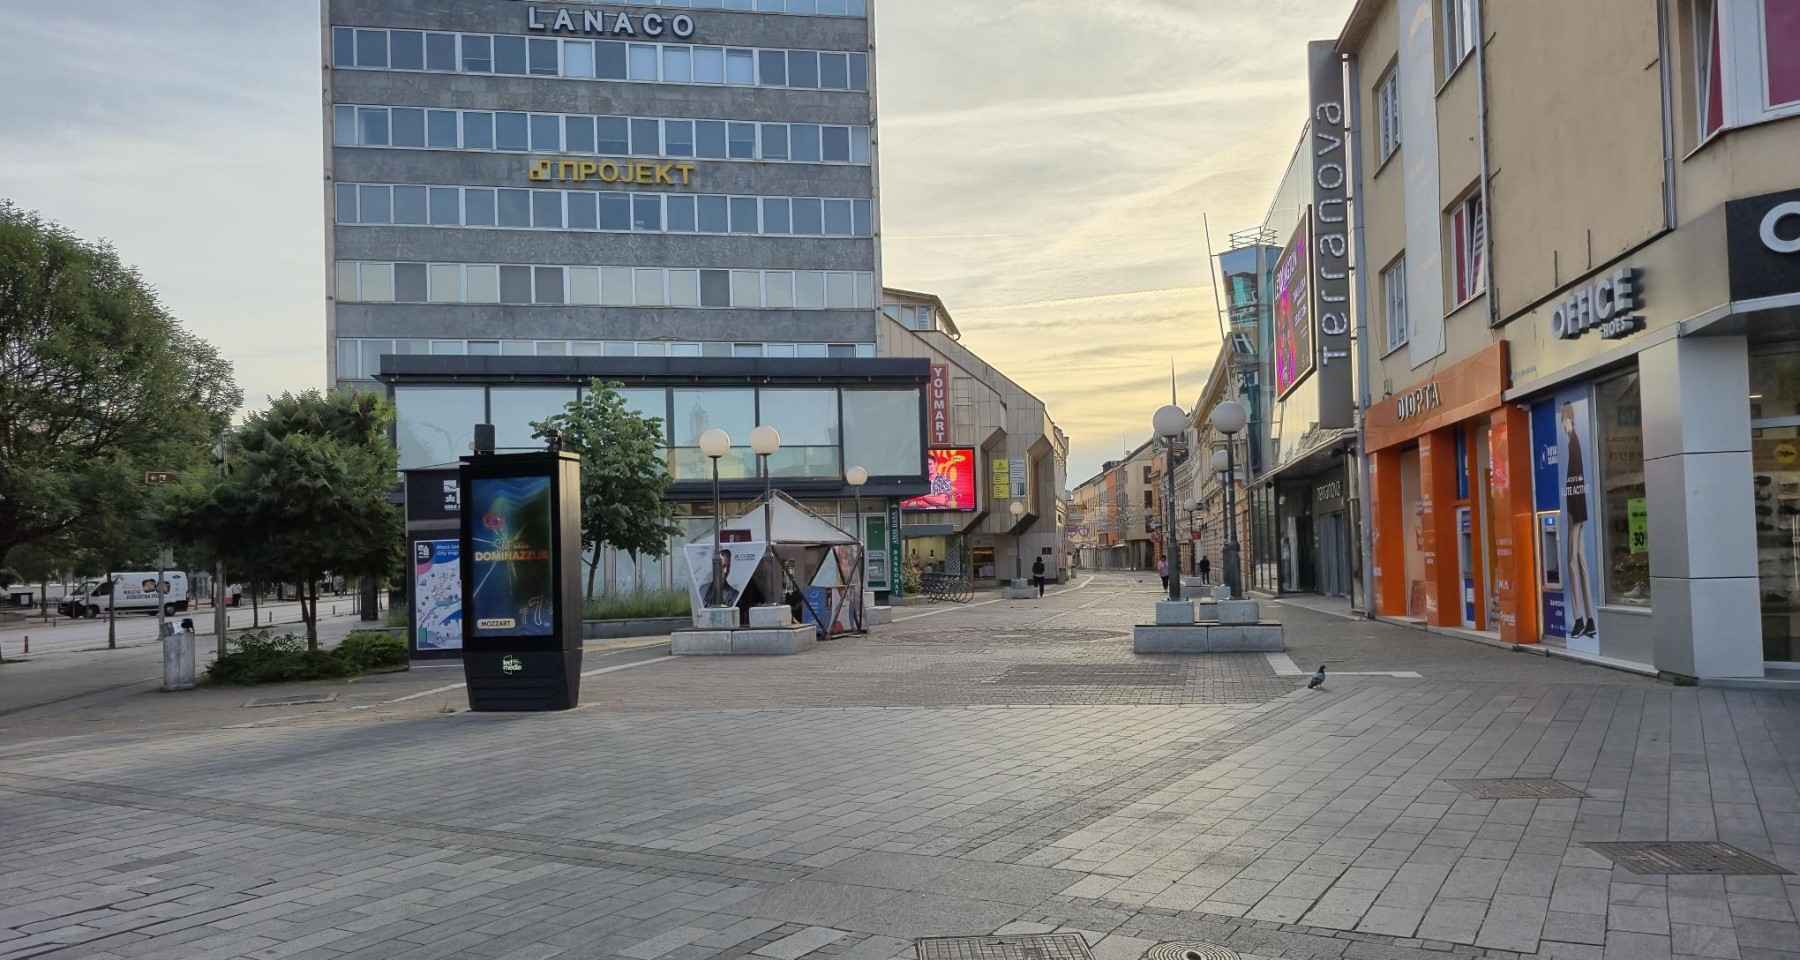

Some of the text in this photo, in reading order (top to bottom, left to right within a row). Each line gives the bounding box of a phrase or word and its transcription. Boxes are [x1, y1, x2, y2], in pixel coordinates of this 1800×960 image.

[528, 6, 695, 37] LANACO
[559, 159, 695, 185] ПРОЈЕКТ
[1552, 267, 1633, 339] OFFICE
[934, 367, 945, 442] YOUMART
